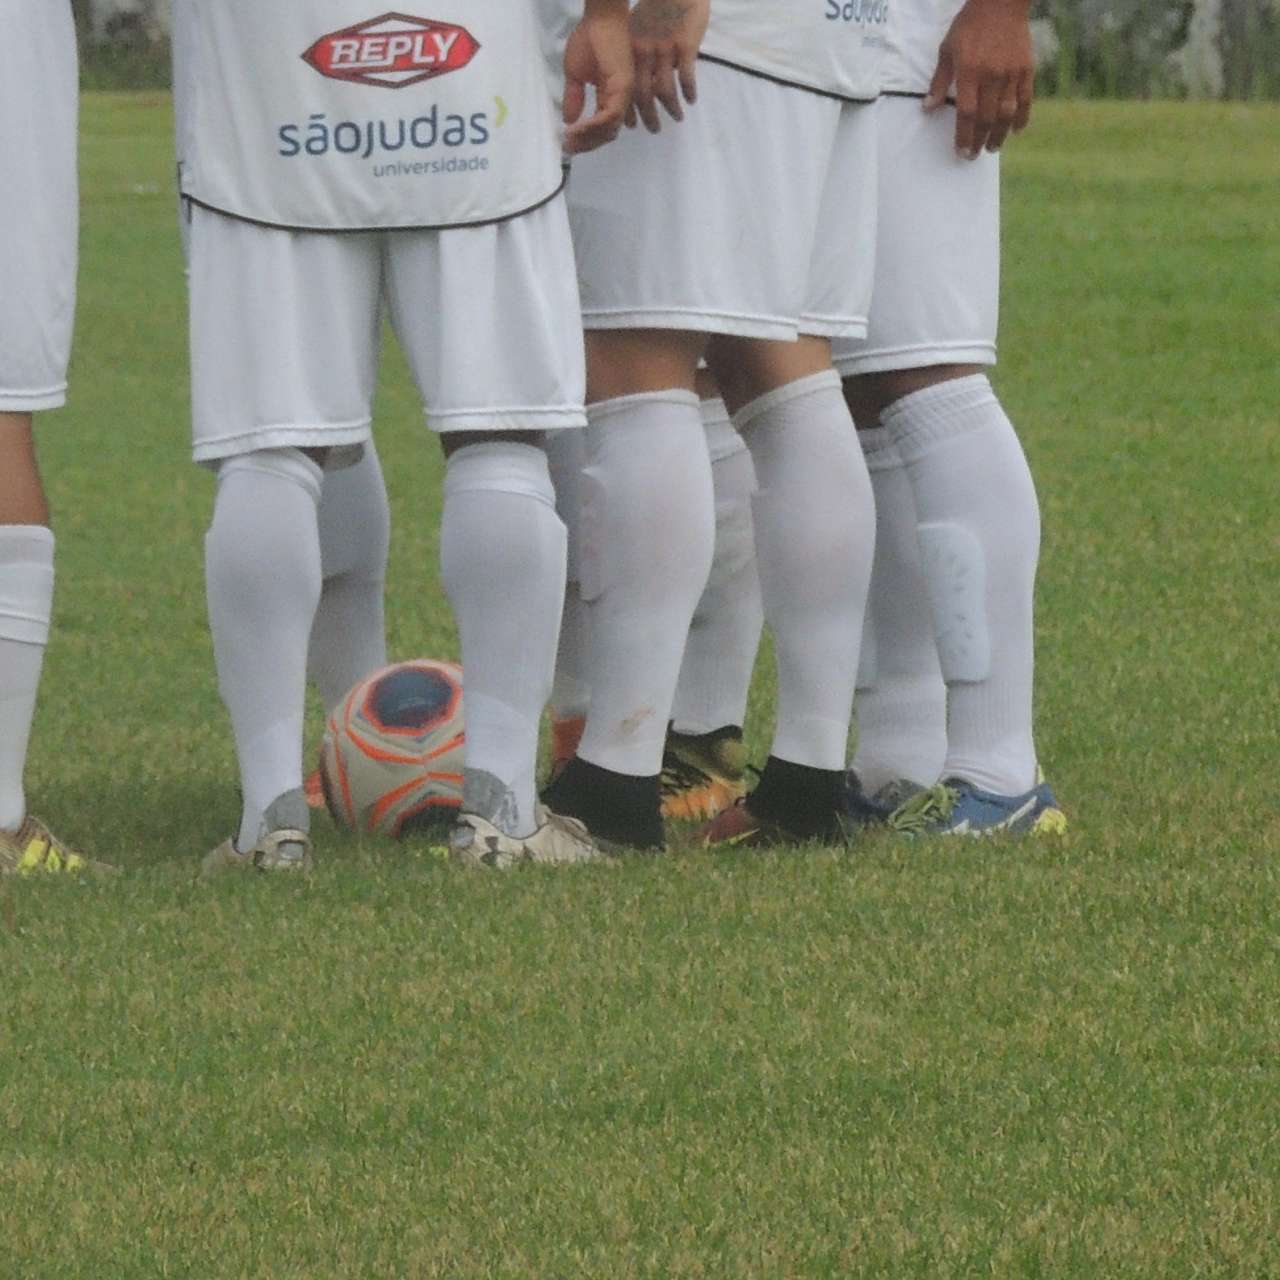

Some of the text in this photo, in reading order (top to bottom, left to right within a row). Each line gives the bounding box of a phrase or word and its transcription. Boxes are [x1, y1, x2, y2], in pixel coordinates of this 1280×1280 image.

[331, 32, 459, 67] REPLY
[278, 104, 490, 159] sãojudas
[372, 154, 490, 177] universidade
